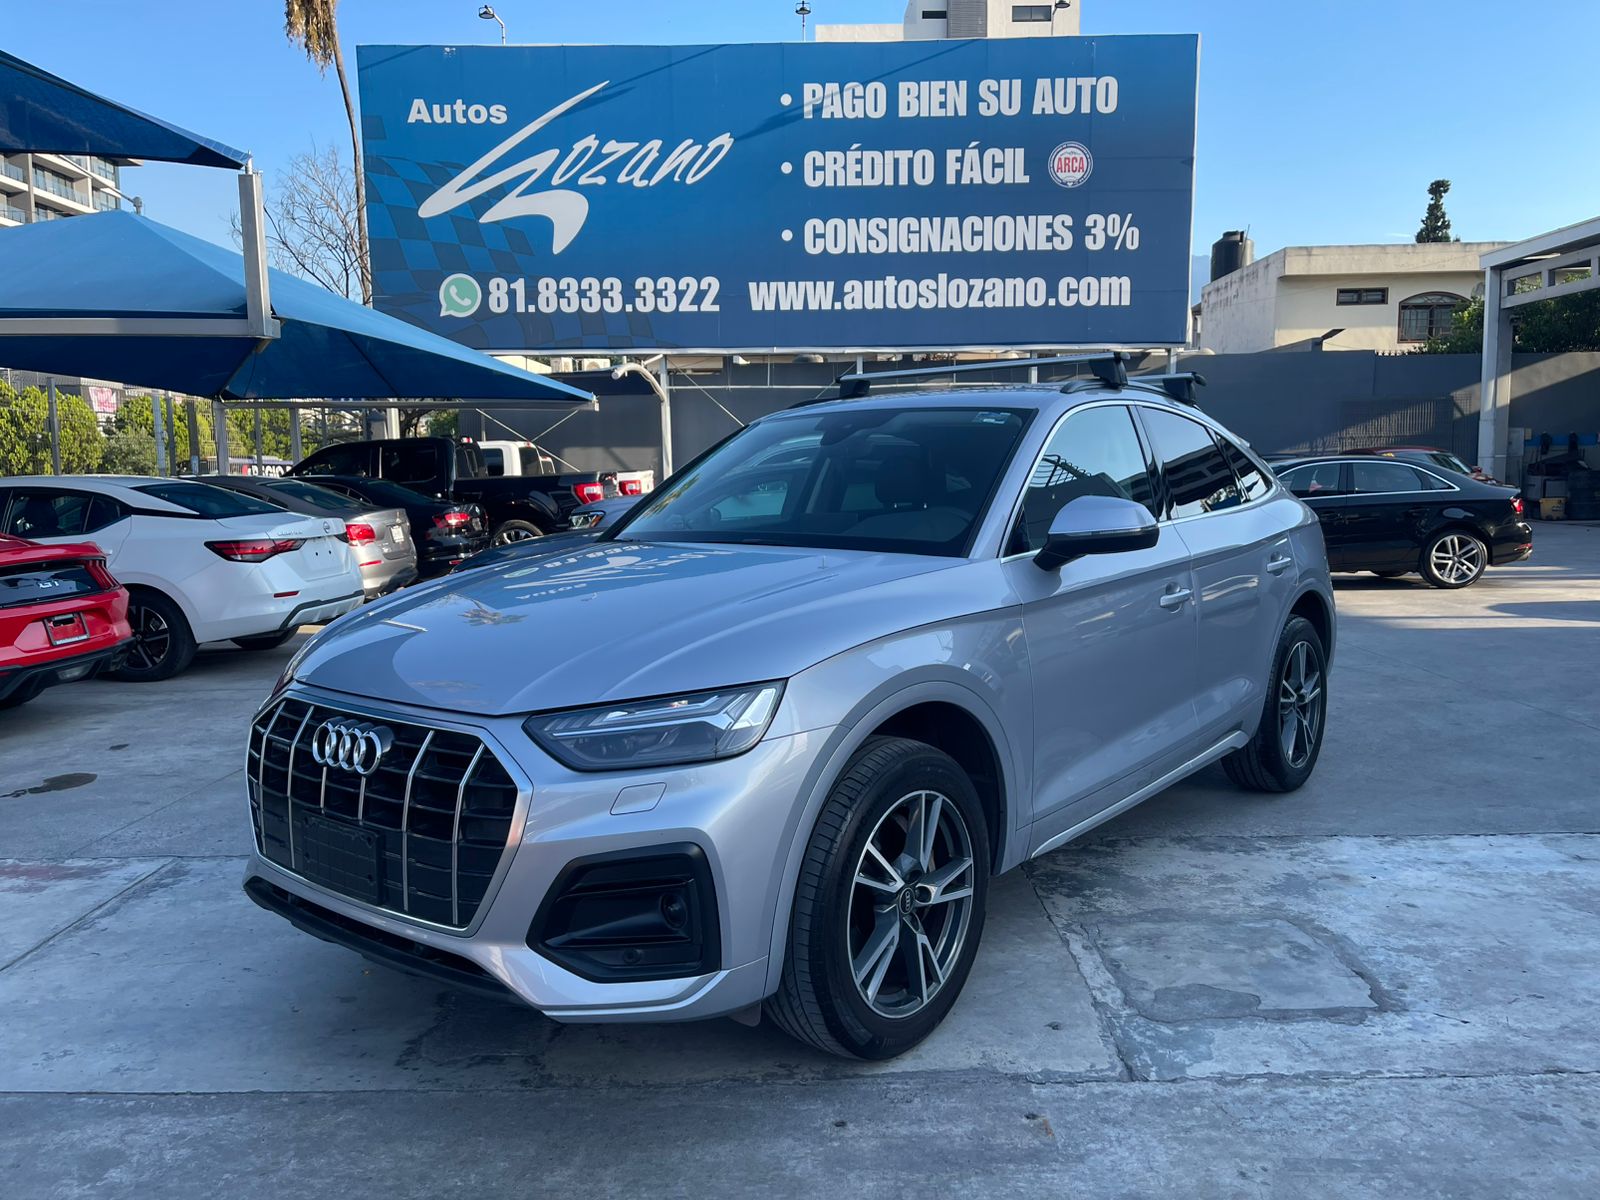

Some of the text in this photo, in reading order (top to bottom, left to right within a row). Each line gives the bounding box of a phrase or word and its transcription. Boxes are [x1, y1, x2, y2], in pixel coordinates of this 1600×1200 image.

[407, 99, 508, 125] Autos
[803, 76, 1119, 119] PAGO BIEN SU AUTO
[418, 80, 734, 255] Lozano
[803, 143, 935, 187] CRÉDITO
[946, 141, 1030, 185] FÁCIL
[1056, 156, 1085, 173] ARCA
[804, 213, 1140, 255] CONSIGNACIONES 3%
[488, 276, 720, 314] 81.8333.3322
[748, 273, 1132, 312] www.autoslozano.com
